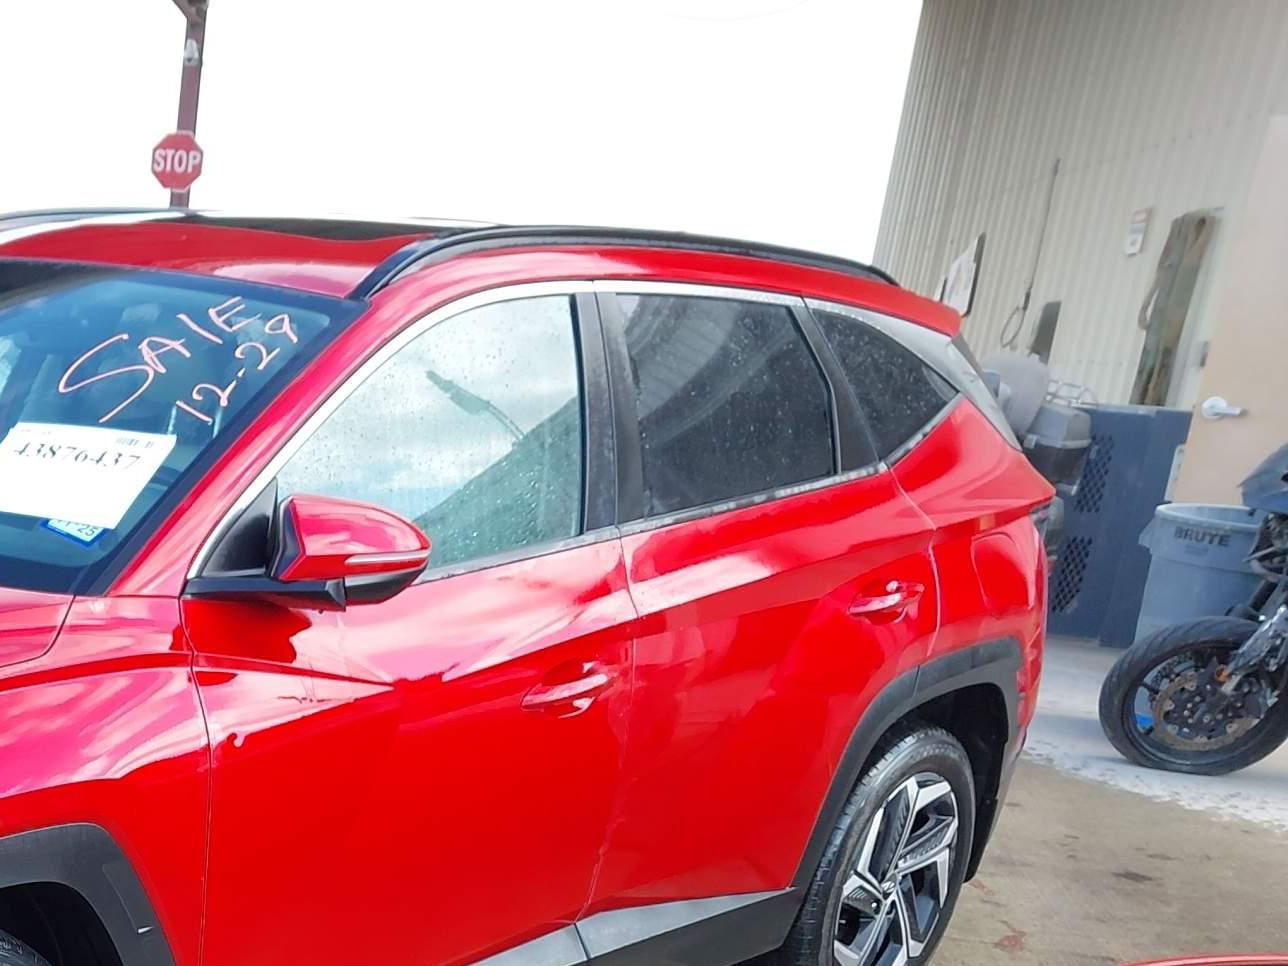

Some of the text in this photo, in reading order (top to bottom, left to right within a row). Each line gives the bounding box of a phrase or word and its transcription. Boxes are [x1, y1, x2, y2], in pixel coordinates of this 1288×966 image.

[153, 148, 201, 173] STOP
[175, 313, 298, 425] 12-29
[14, 441, 141, 470] 43876437
[1174, 526, 1231, 548] BRUTE
